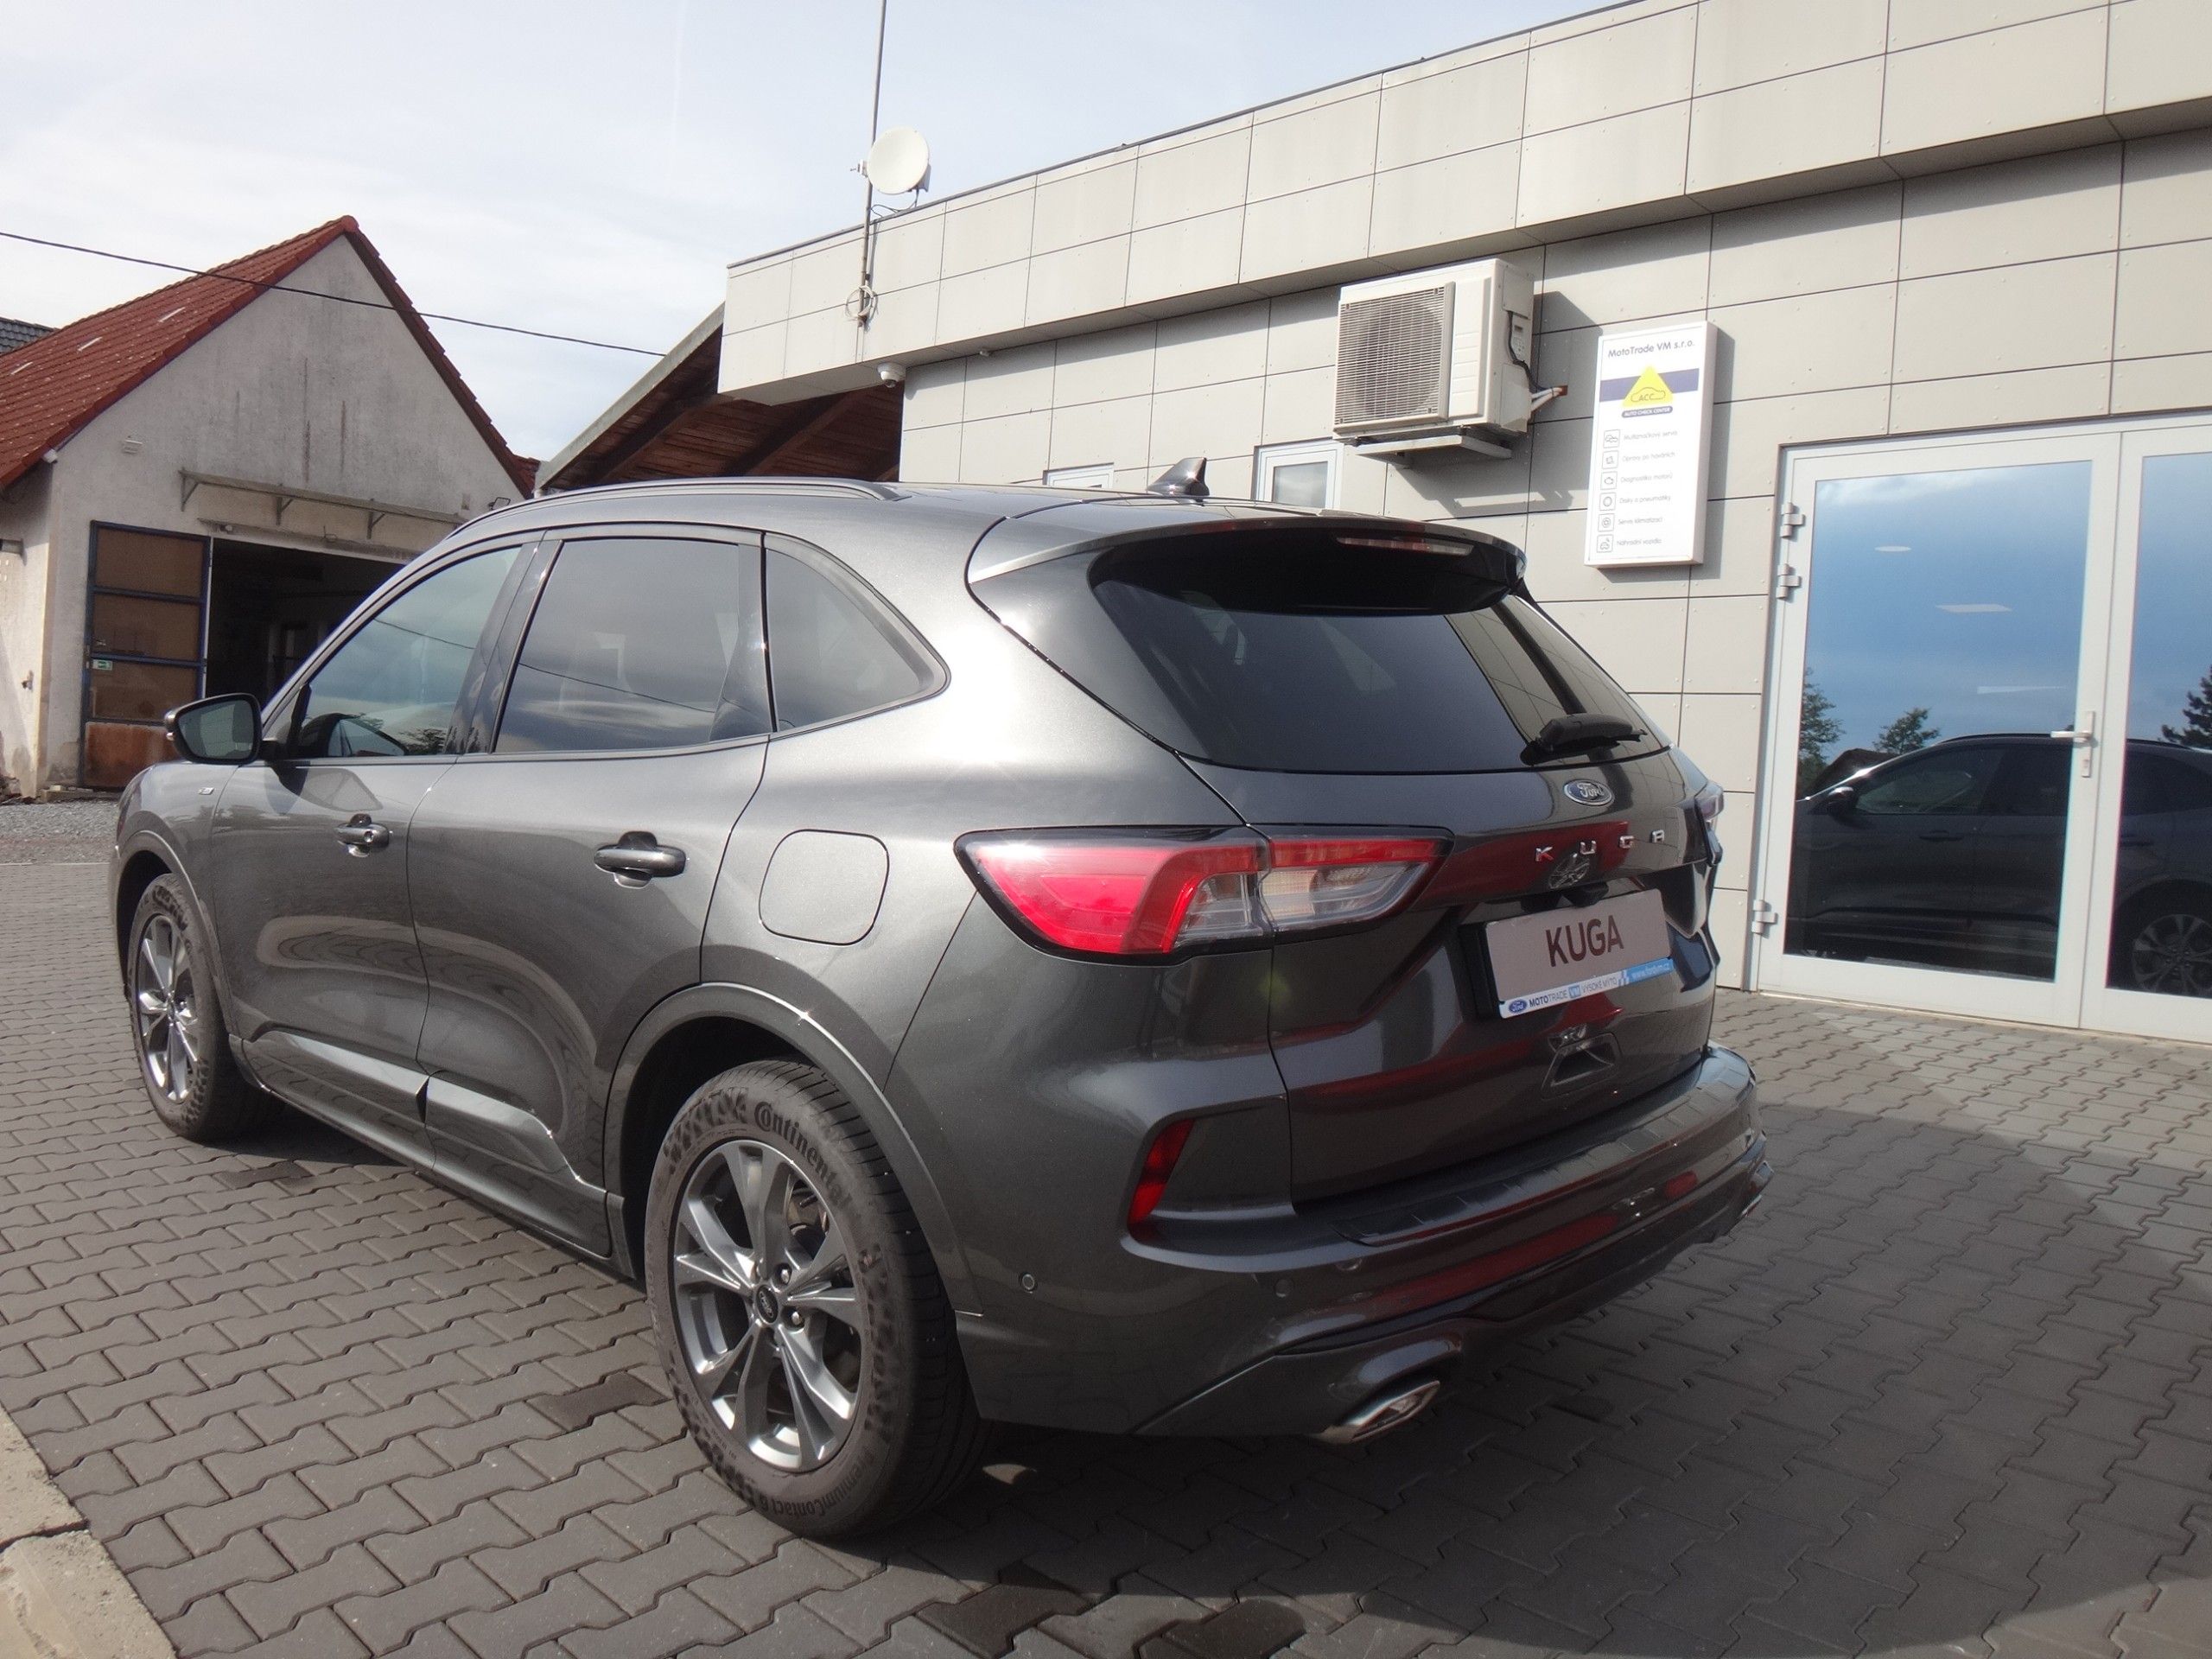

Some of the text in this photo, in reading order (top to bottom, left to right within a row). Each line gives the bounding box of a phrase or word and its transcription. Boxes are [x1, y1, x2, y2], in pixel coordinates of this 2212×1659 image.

[1608, 340, 1695, 358] MotoTrade VM s.r.o.
[1638, 393, 1655, 402] ACC
[1535, 830, 1665, 862] KUGA
[1545, 914, 1624, 968] KUGA
[1529, 989, 1568, 1007] MOTOTRADE
[753, 1101, 854, 1207] Continental
